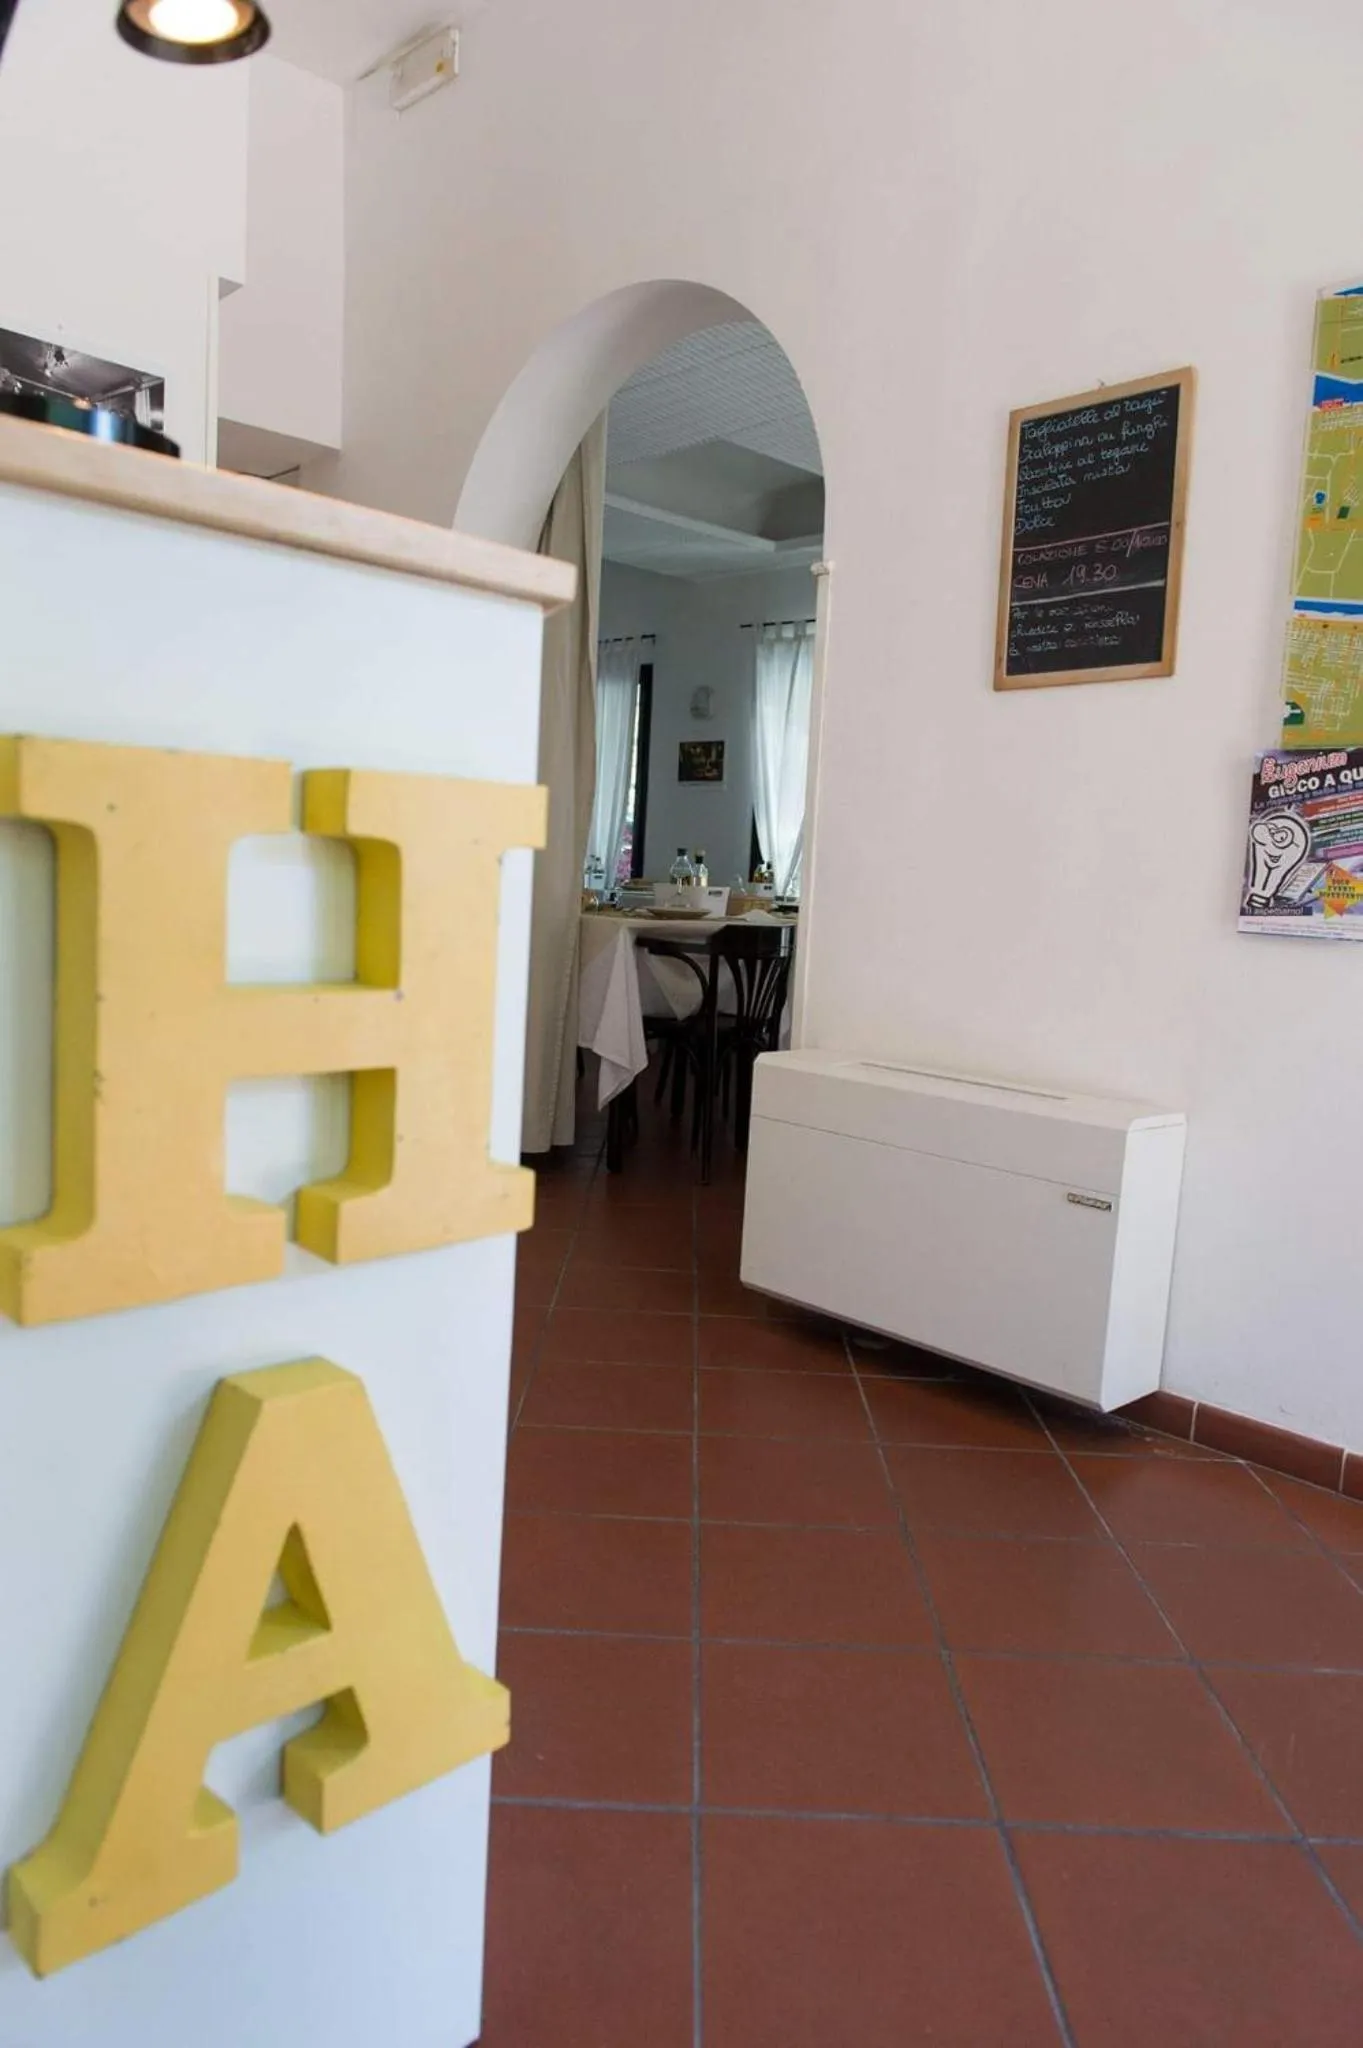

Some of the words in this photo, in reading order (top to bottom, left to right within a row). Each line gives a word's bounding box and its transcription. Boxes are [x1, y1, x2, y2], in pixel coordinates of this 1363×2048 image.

[1022, 409, 1101, 442] Tagliatelle
[1121, 414, 1169, 440] funghi
[1015, 515, 1055, 536] Dolce
[1017, 545, 1088, 566] COLAZIONE
[1014, 574, 1049, 590] CENA
[1324, 773, 1336, 787] A
[0, 735, 547, 1327] H
[4, 1355, 511, 1979] A
